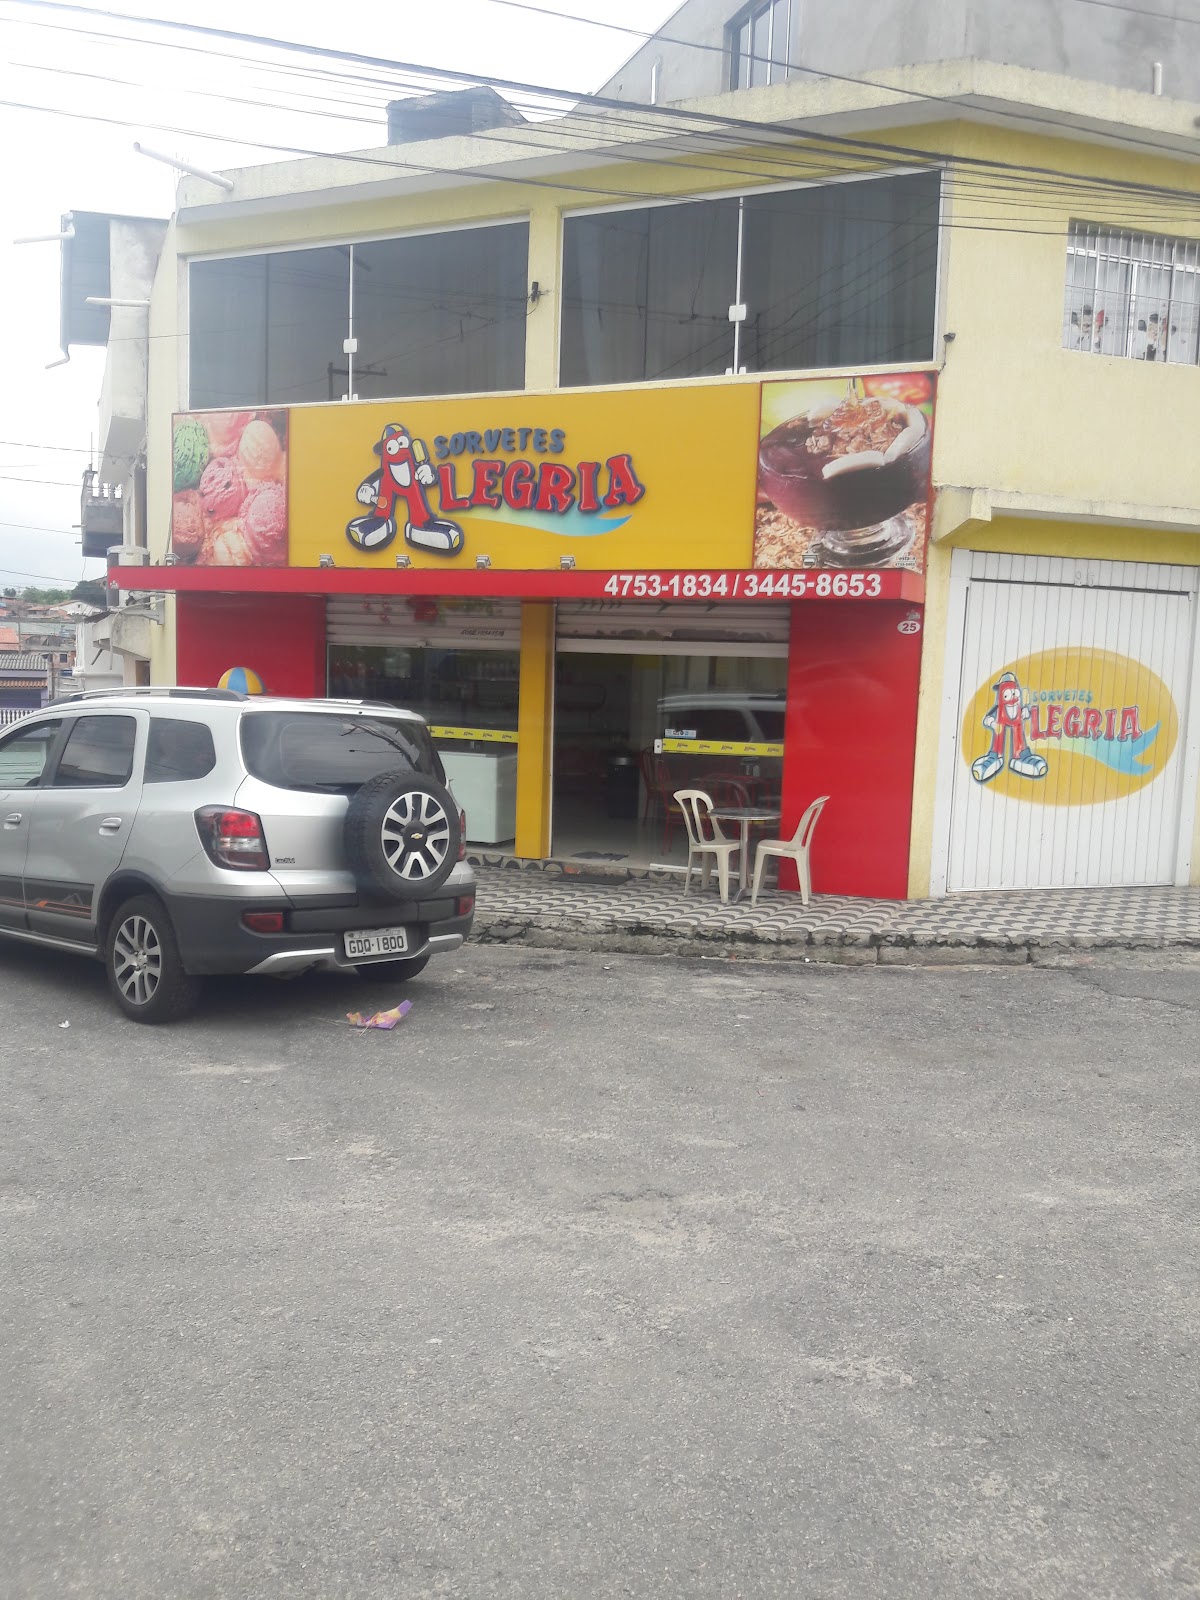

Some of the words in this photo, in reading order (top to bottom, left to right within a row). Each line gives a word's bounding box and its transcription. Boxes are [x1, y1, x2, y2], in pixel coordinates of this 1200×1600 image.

[433, 427, 566, 459] SORVETES
[604, 574, 728, 596] 4753-1834
[744, 574, 882, 597] 3445-8653
[902, 623, 916, 631] 25
[1032, 689, 1093, 704] SORVETES
